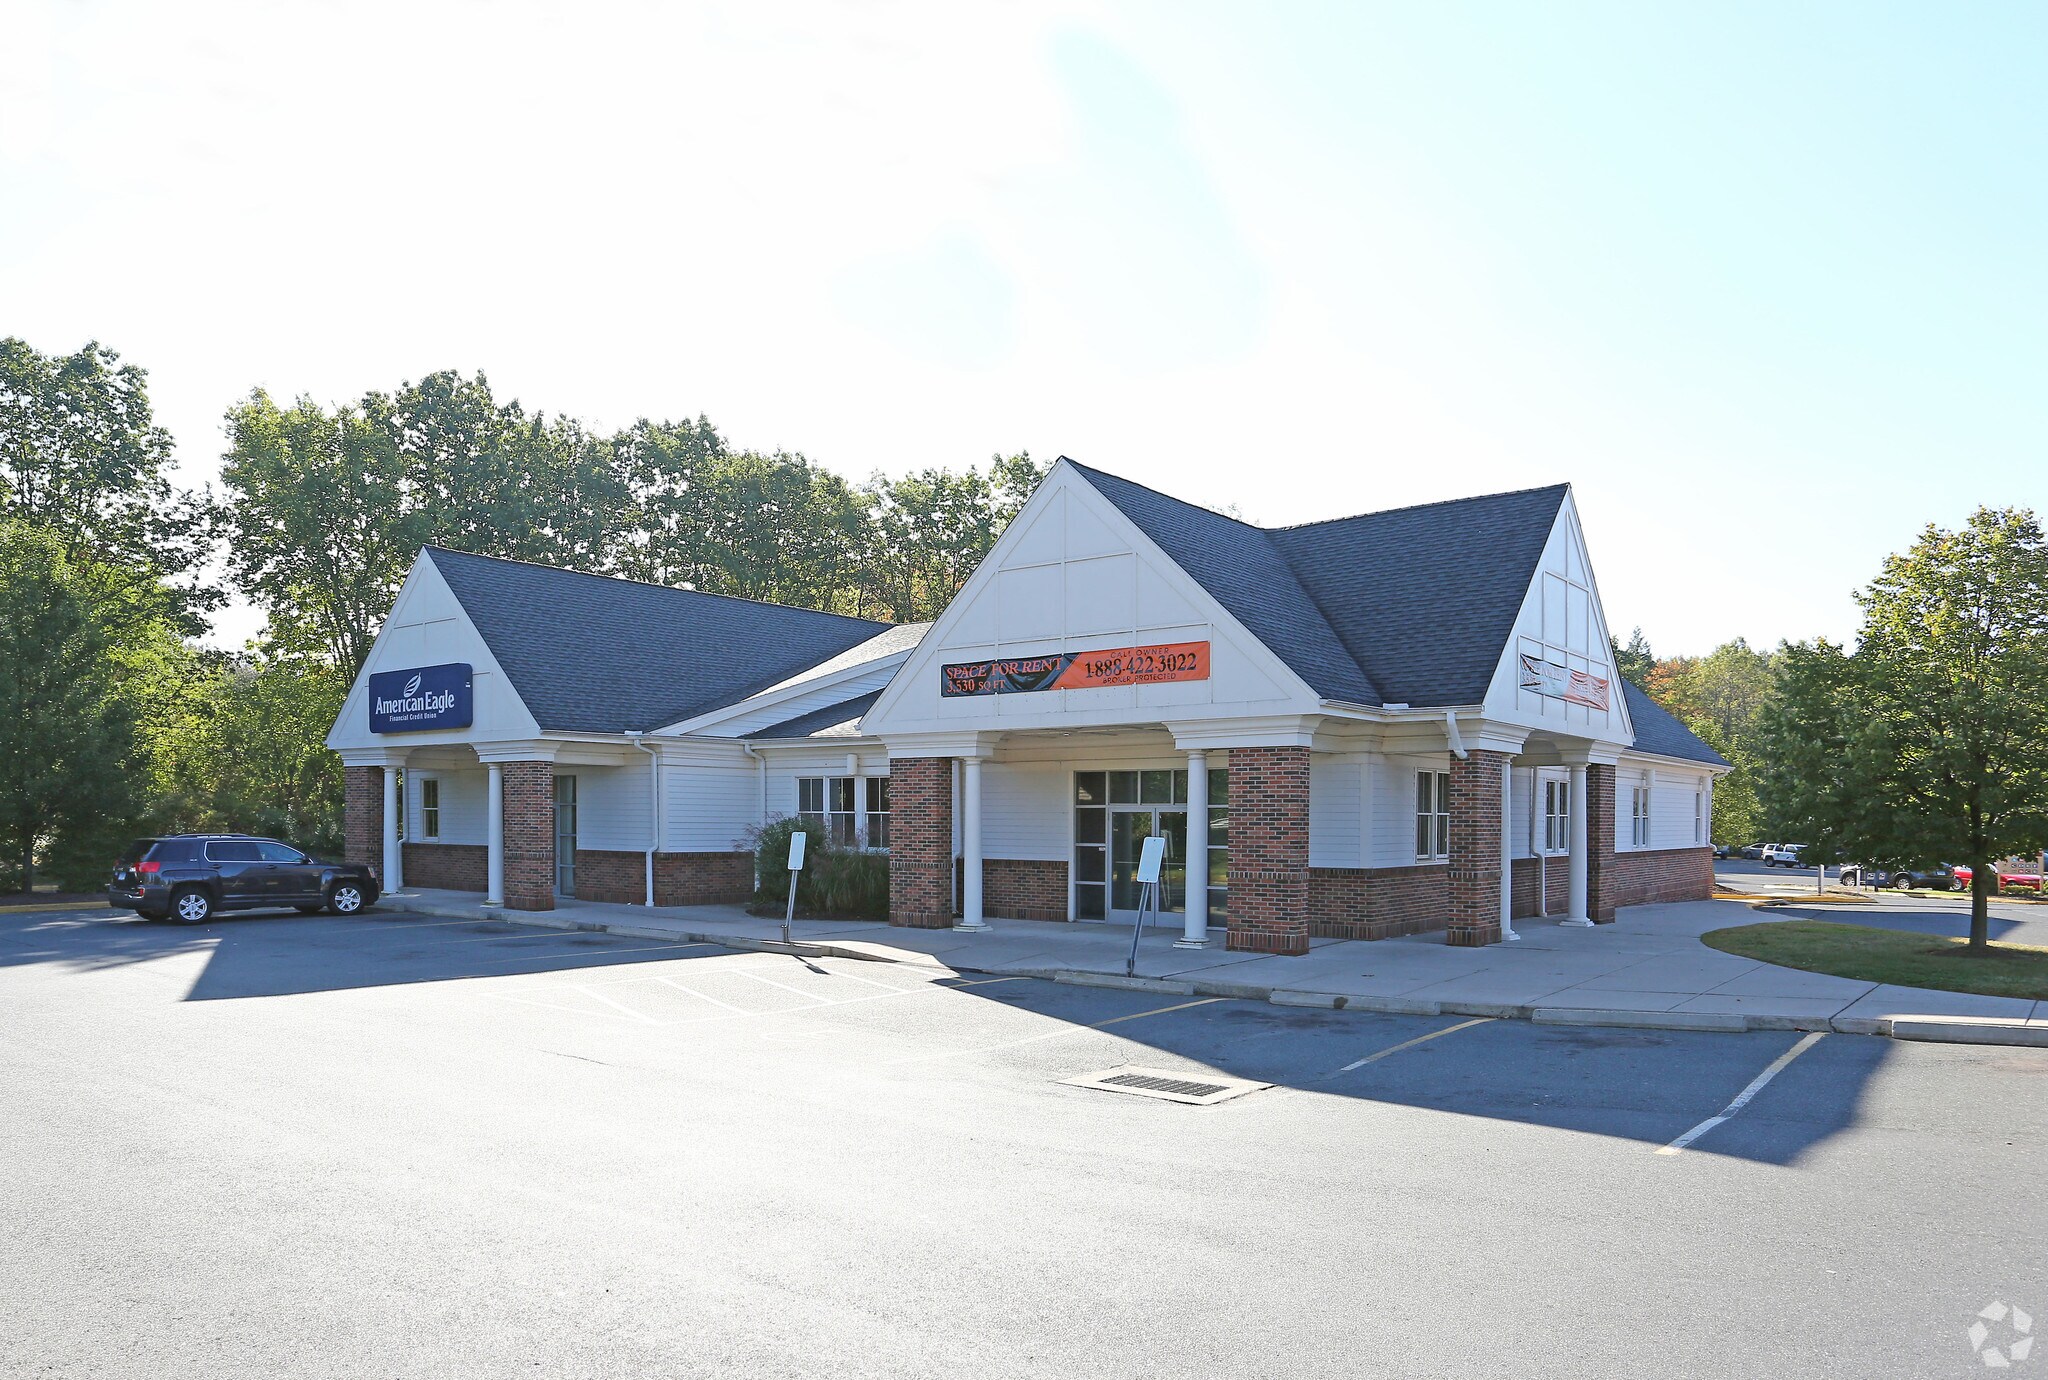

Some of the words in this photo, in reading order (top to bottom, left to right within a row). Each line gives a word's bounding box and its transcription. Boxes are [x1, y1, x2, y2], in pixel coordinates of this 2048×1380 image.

[1110, 650, 1131, 658] CALL
[1136, 647, 1169, 656] OWNER
[946, 666, 987, 679] SPACE
[991, 662, 1019, 675] FOR
[1022, 657, 1063, 673] RENT
[1102, 675, 1132, 684] BROKER
[1134, 672, 1176, 682] PROTECTED
[946, 679, 975, 693] 3,530
[978, 681, 991, 691] SQ
[993, 679, 1006, 689] FT
[375, 696, 424, 714] American
[425, 689, 455, 713] Eagle
[389, 714, 409, 722] Financial
